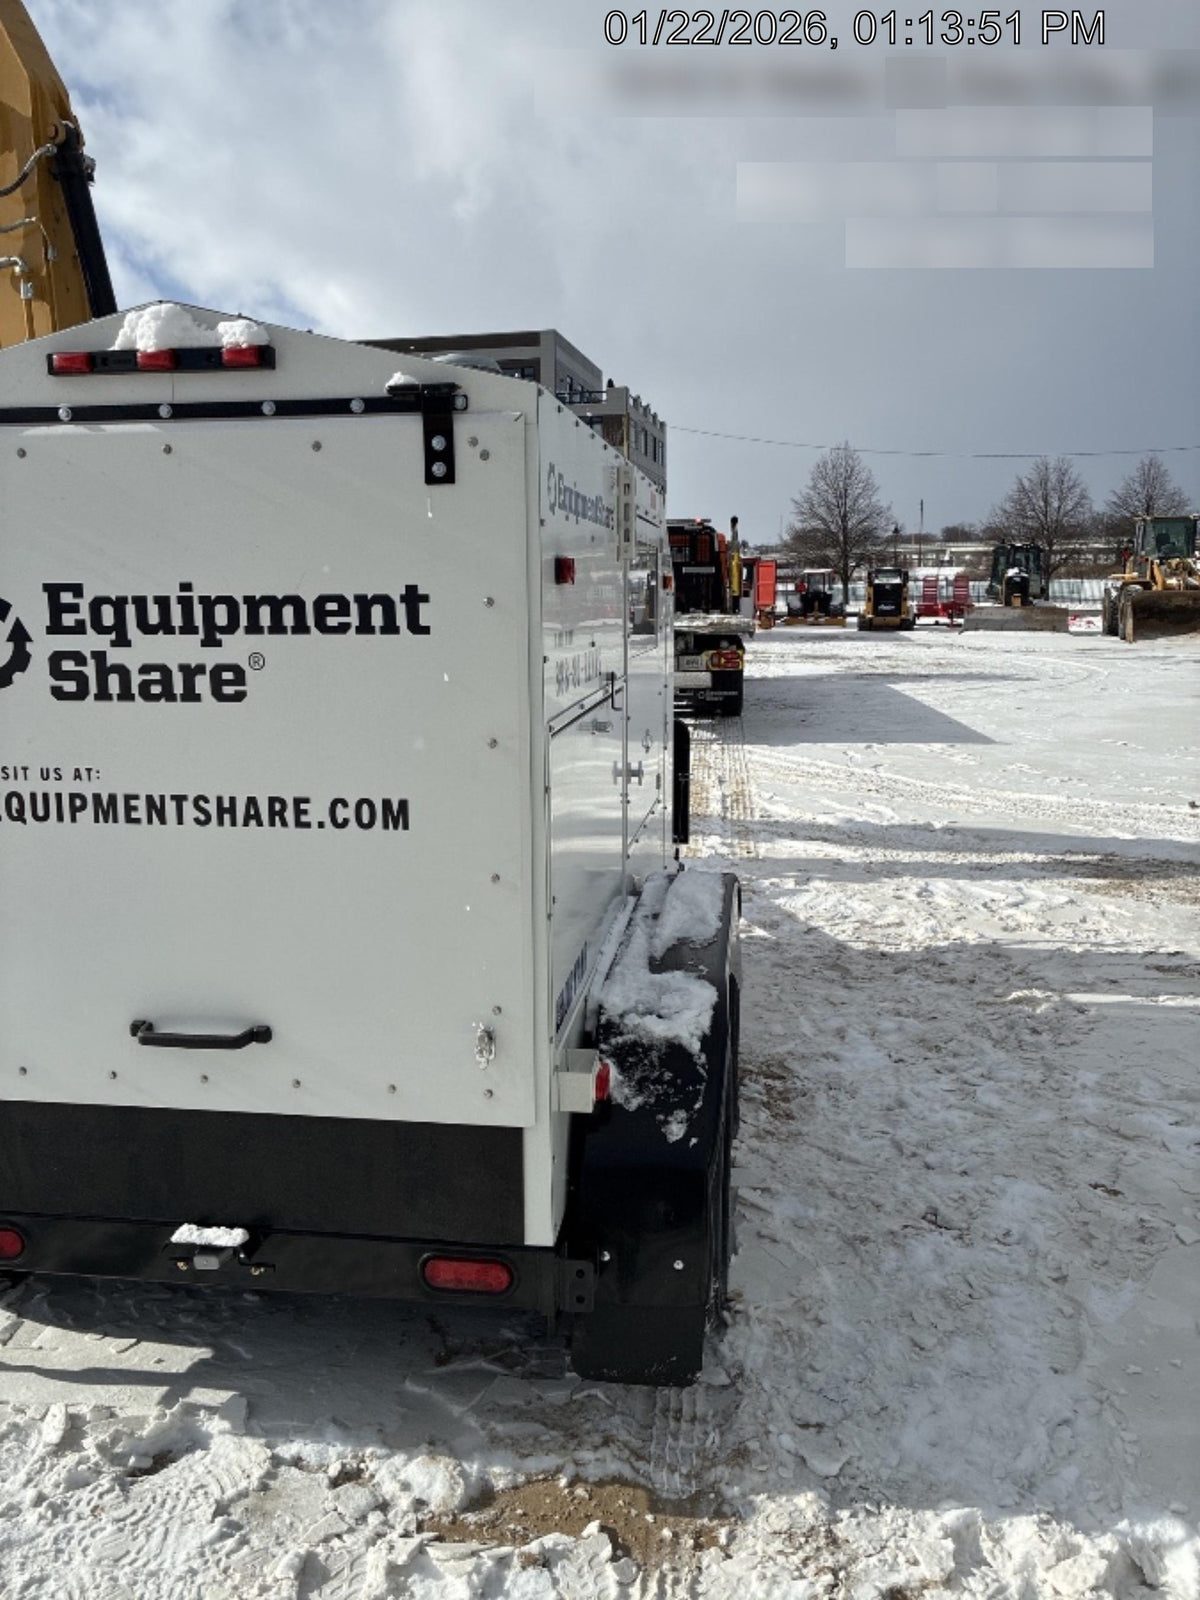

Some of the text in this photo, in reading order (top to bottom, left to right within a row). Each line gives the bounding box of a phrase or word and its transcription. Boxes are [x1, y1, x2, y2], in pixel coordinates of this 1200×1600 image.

[42, 581, 431, 648] Equipment
[0, 765, 101, 782] SIT US AT:
[0, 790, 410, 831] QUIPMENTSHARE.COM
